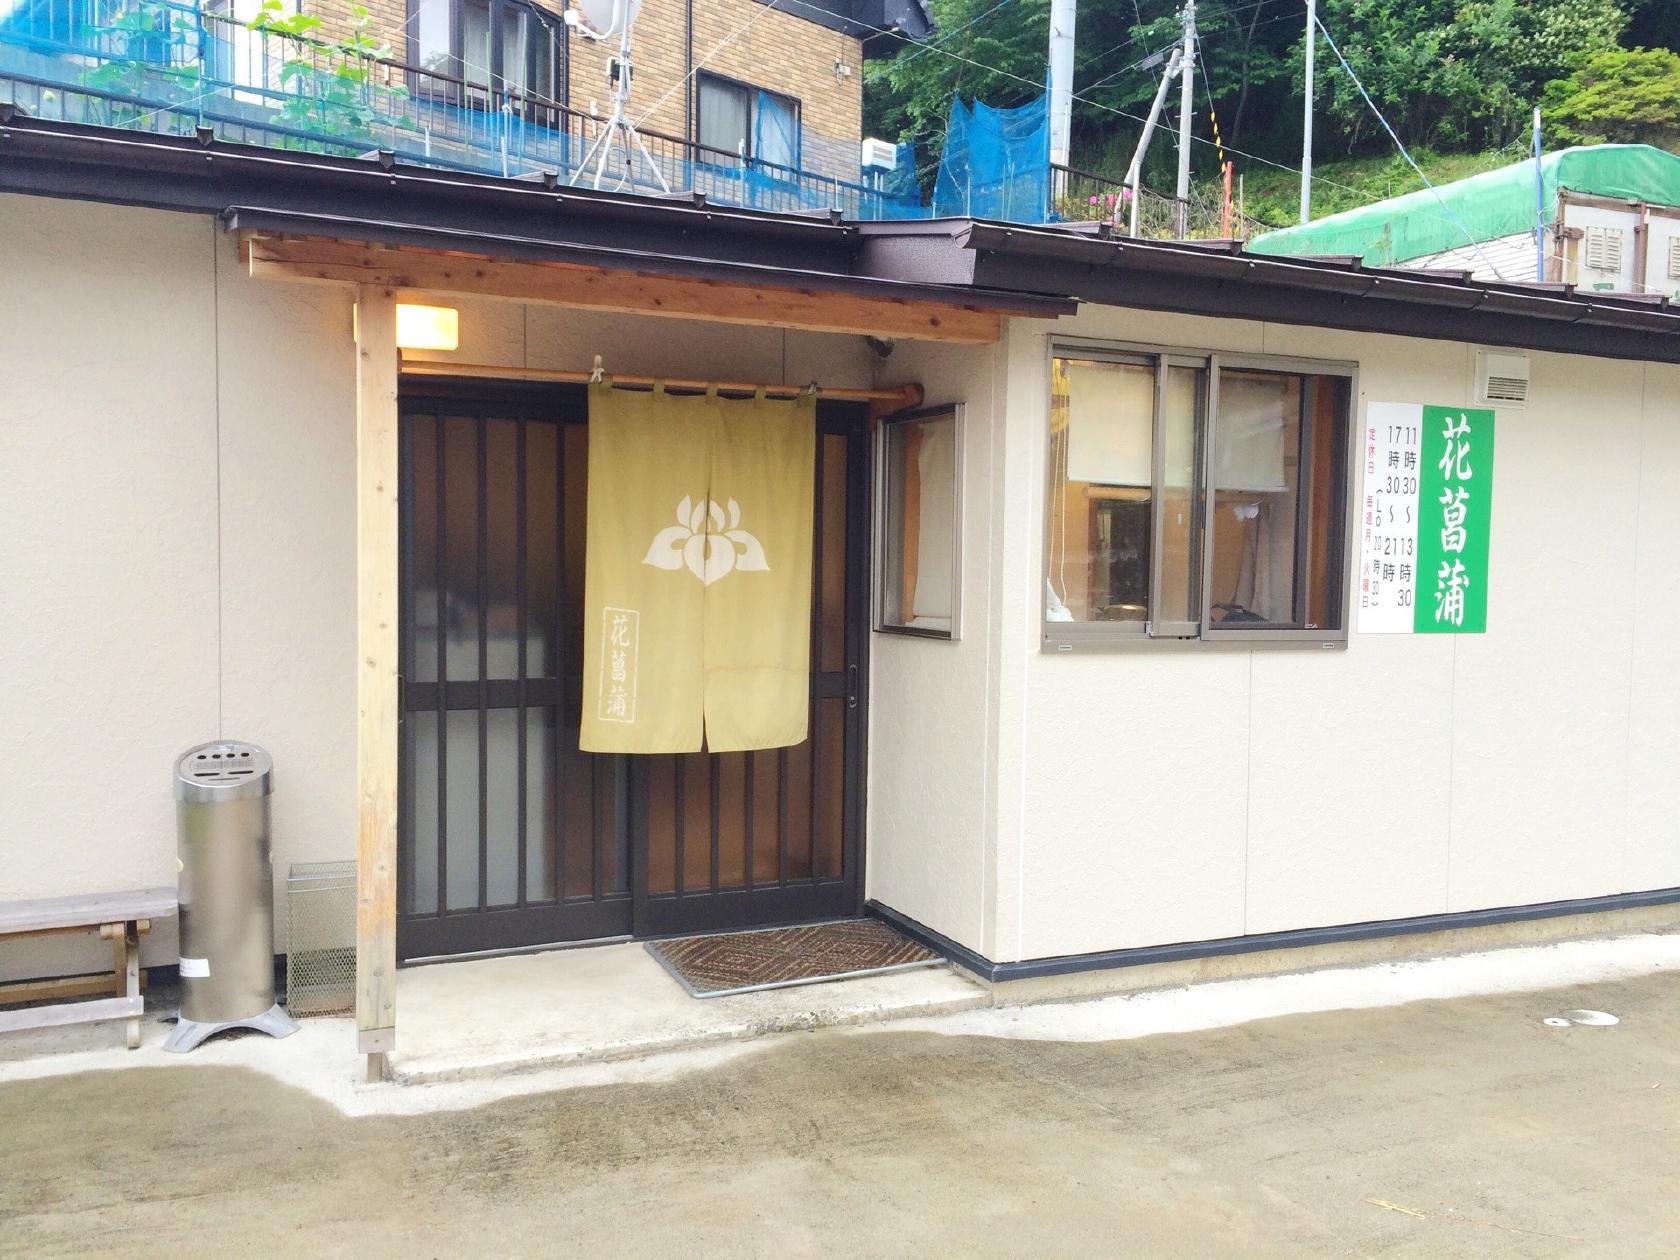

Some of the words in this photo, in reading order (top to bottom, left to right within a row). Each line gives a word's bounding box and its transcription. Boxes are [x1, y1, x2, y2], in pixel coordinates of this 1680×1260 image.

[1433, 412, 1473, 627] 花菖蒲
[607, 614, 631, 718] 花菖蒲
